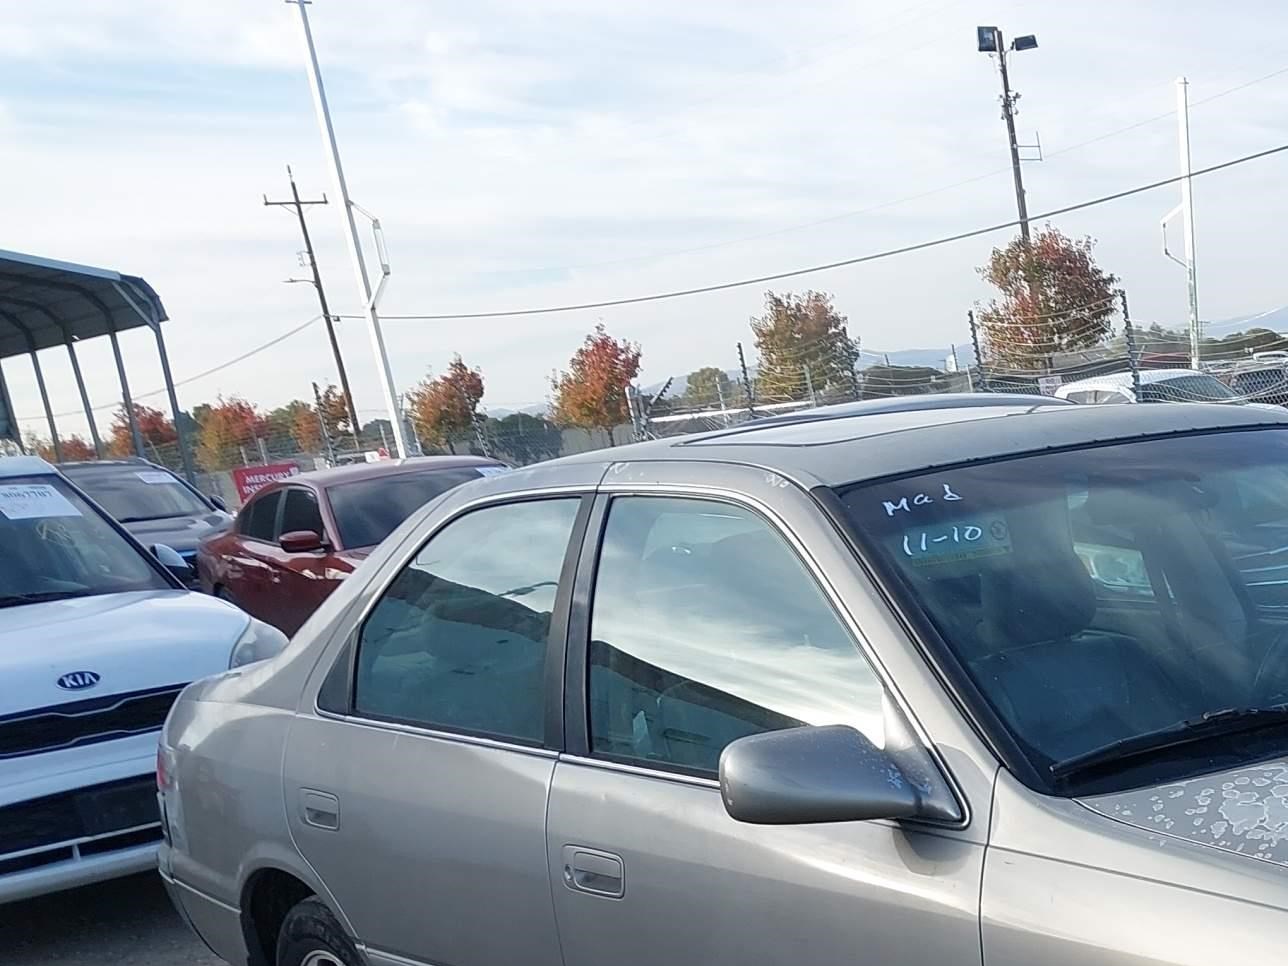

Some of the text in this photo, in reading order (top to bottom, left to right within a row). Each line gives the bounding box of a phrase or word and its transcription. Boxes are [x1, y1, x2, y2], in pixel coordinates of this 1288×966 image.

[246, 471, 289, 484] MERCURY
[903, 526, 982, 556] 11-10
[62, 672, 97, 687] KIA
